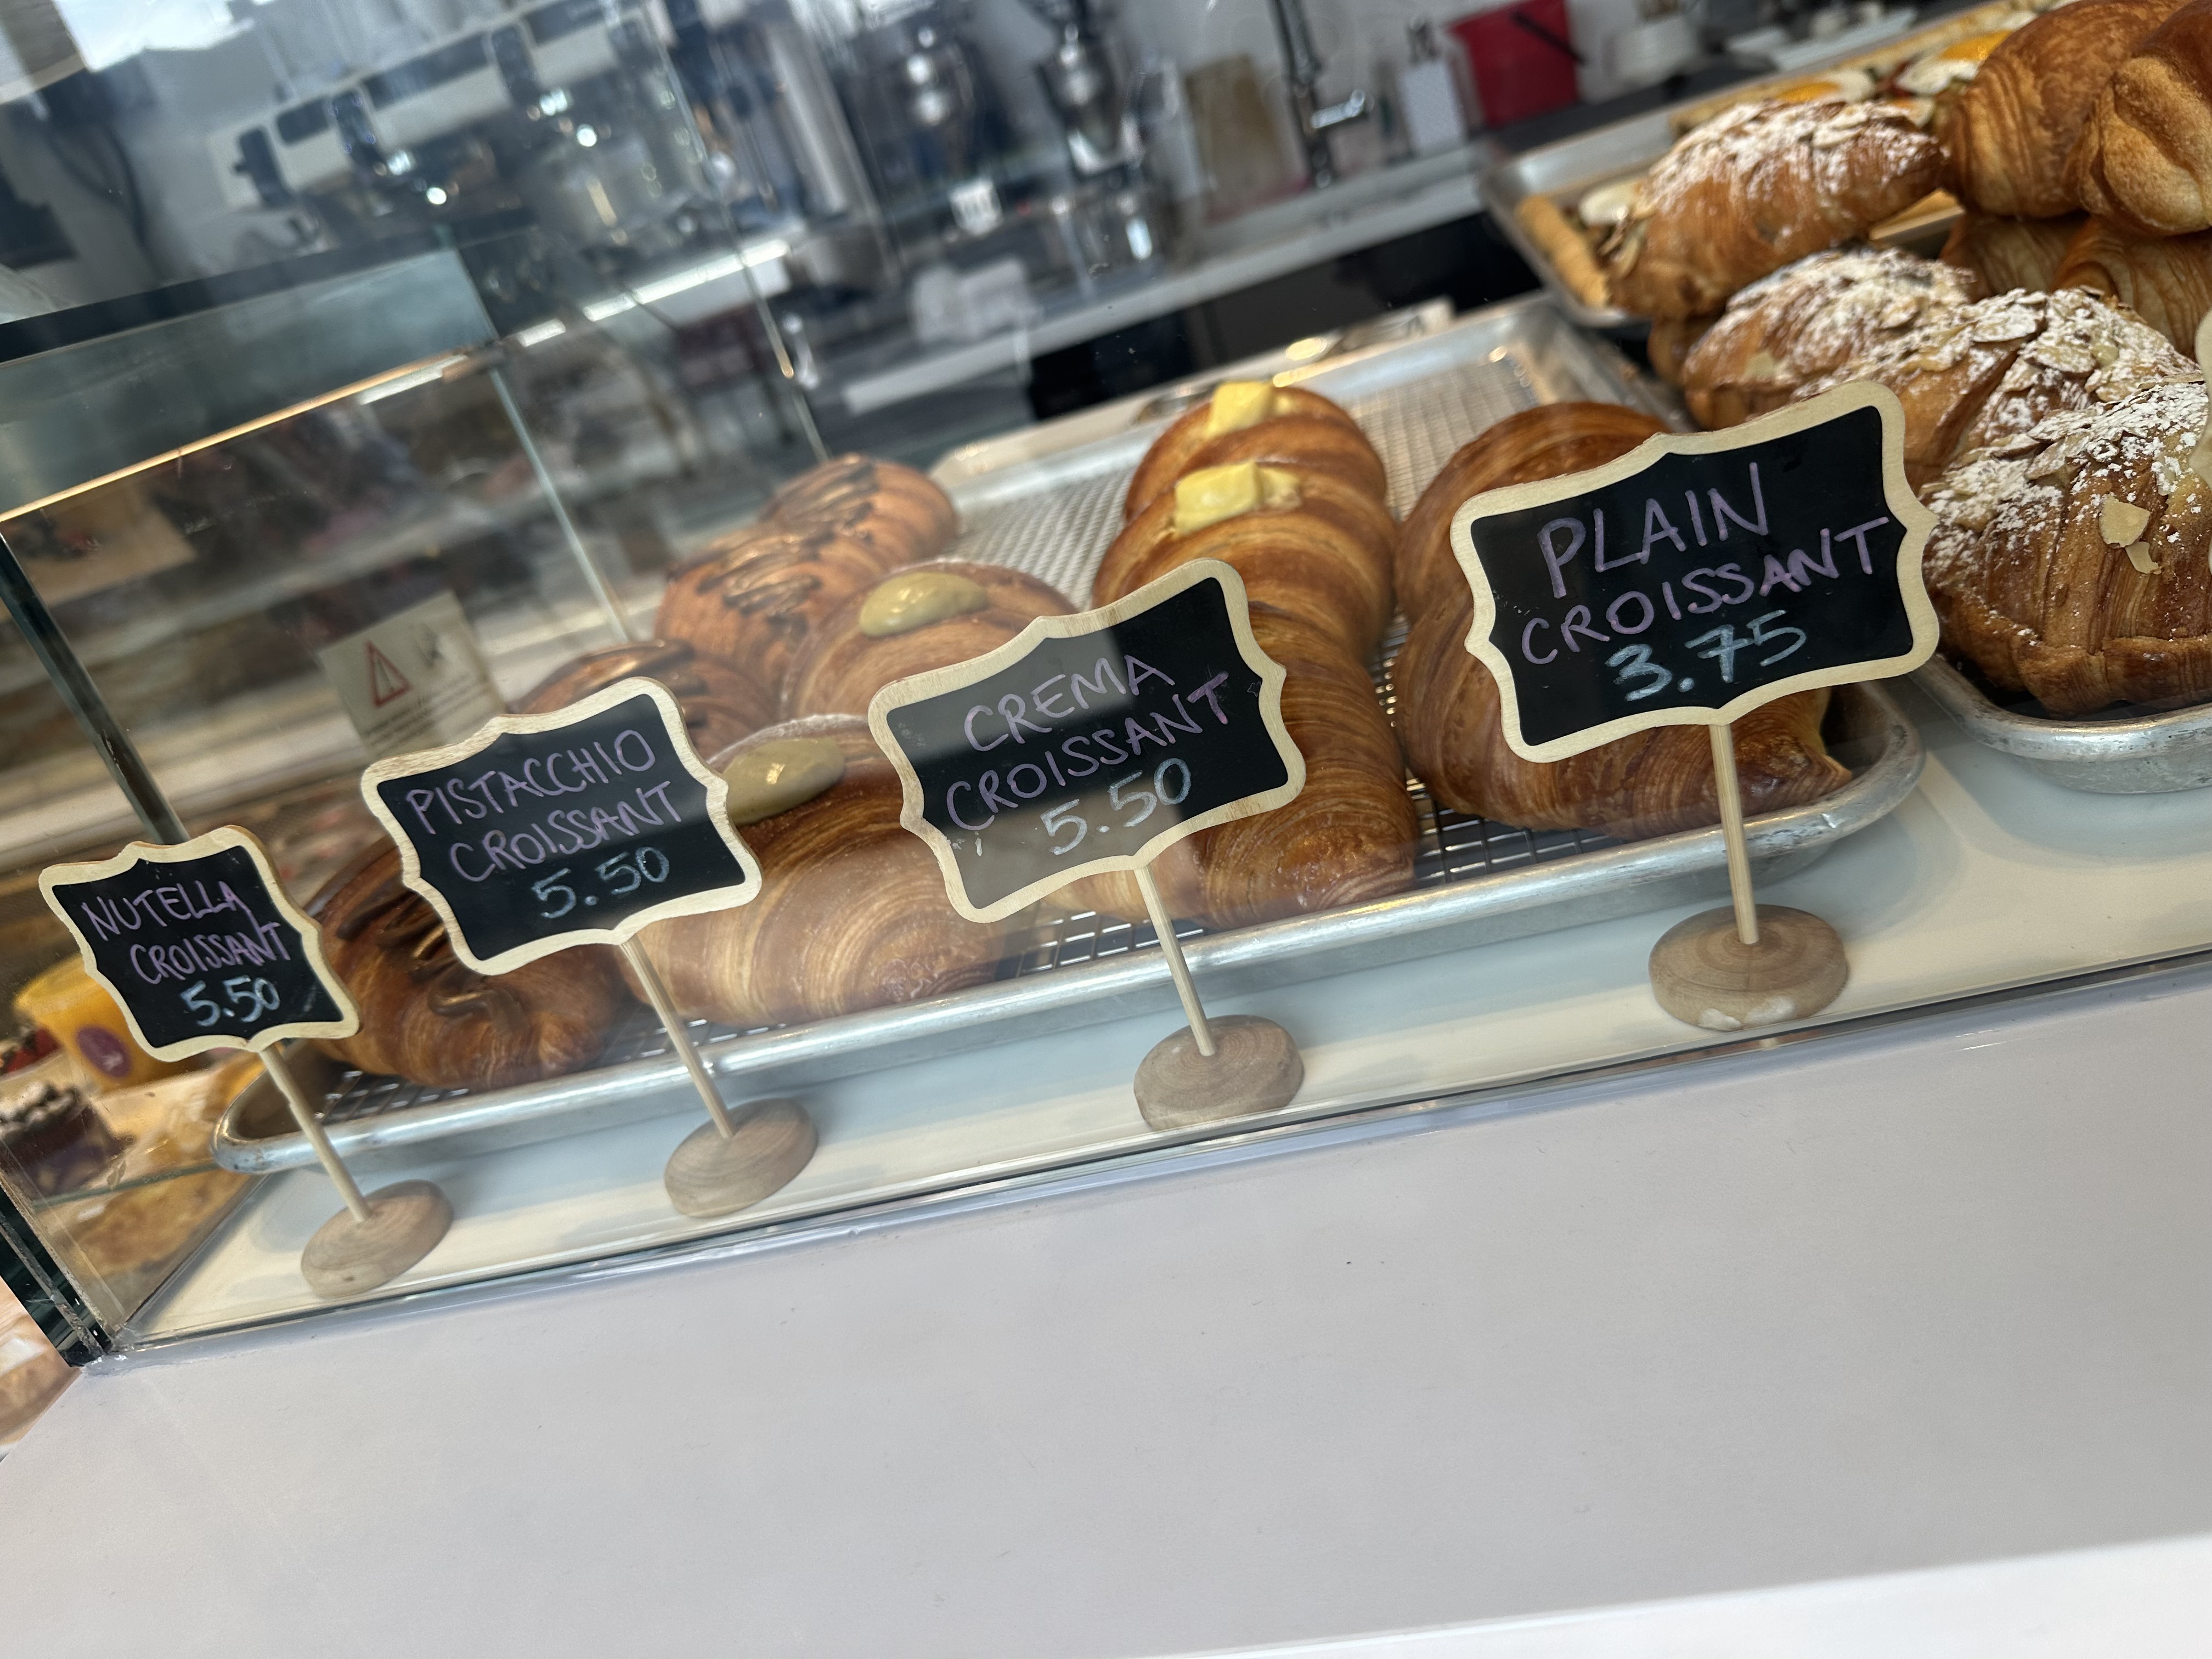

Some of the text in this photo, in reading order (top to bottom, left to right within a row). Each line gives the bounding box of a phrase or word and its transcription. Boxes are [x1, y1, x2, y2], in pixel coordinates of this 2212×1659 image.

[1537, 462, 1769, 598] PLAIN
[1521, 517, 1889, 664] CROISSANT
[964, 654, 1176, 752] CREMA
[1605, 610, 1808, 702] 3.75
[405, 730, 656, 834] PISTACCHIO
[946, 672, 1229, 831] CROISSANT
[449, 781, 682, 882] CROISSANT
[1040, 758, 1192, 855] 5.50
[82, 881, 252, 941] NUTELLA
[531, 847, 670, 918] 5.50
[130, 922, 291, 985] CROISSANT
[179, 975, 280, 1026] 5.50
